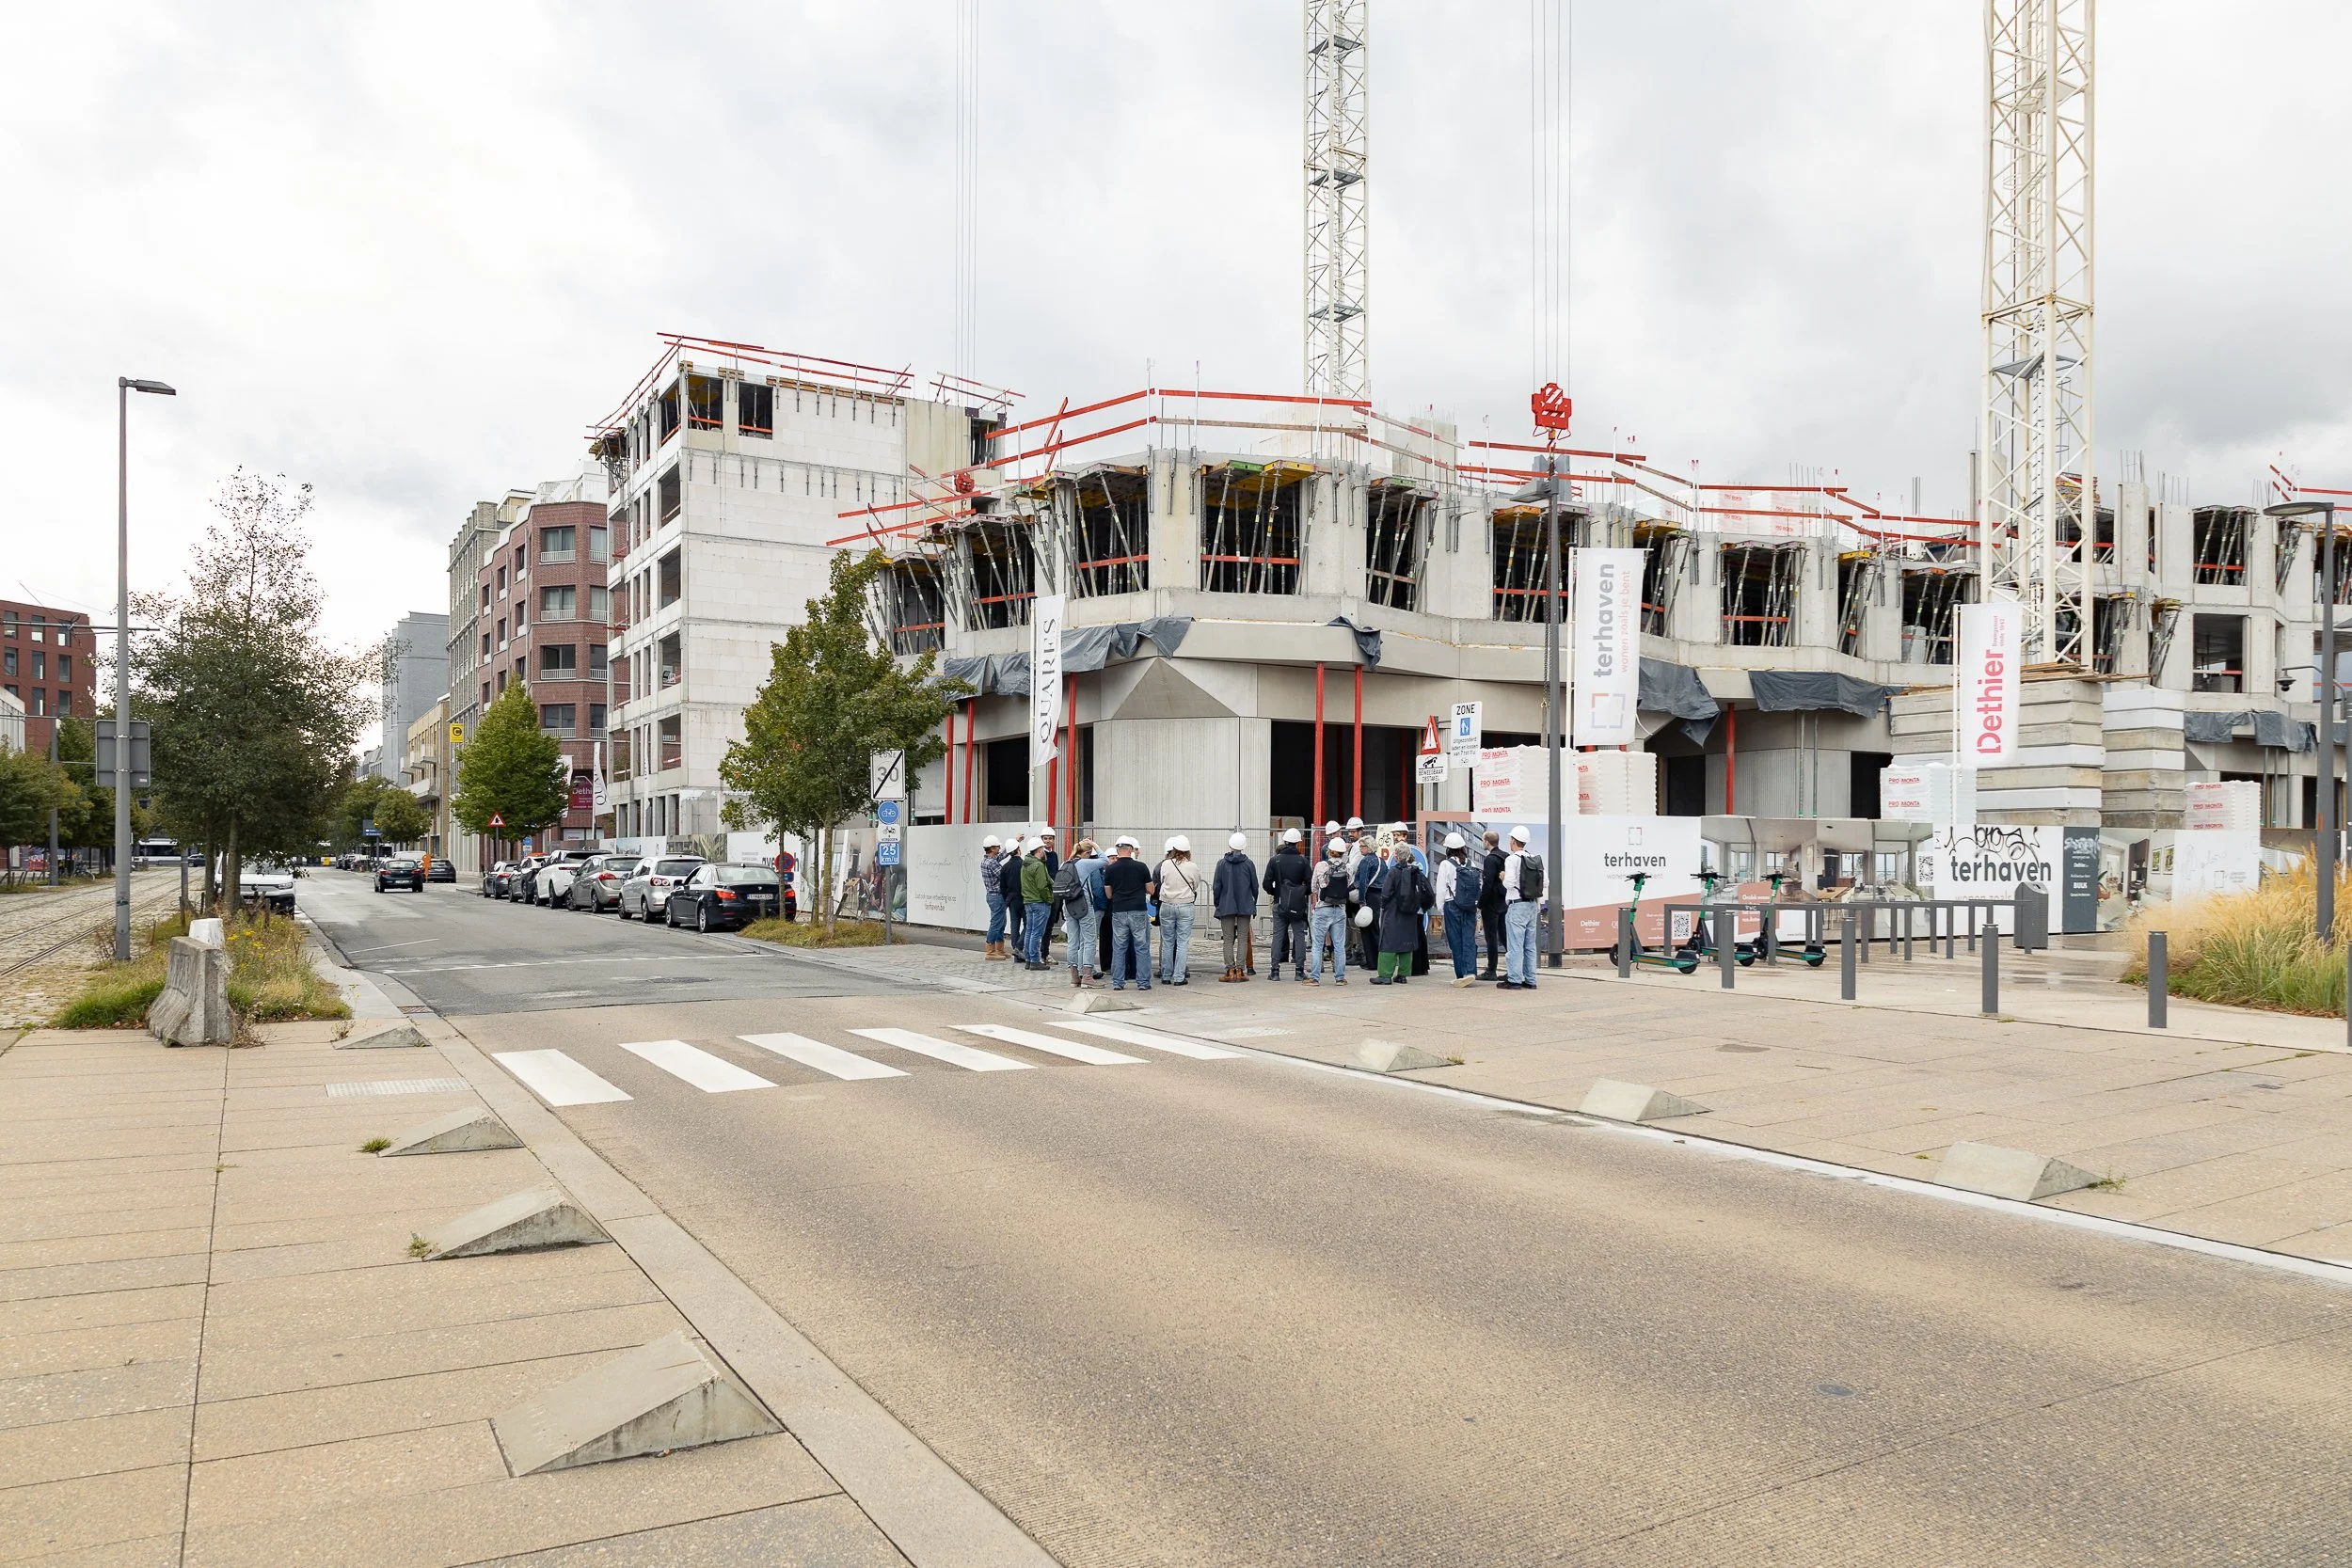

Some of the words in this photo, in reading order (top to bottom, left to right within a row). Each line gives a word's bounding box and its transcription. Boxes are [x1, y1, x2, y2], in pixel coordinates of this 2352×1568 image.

[1619, 570, 1630, 595] bent
[1621, 598, 1632, 610] je
[1593, 563, 1614, 678] terhaven
[1618, 610, 1629, 635] zoals
[1621, 638, 1629, 673] wonen
[1040, 618, 1057, 744] QUARES
[1456, 704, 1475, 715] ZONE
[1977, 649, 2004, 753] Dethier
[877, 767, 899, 782] 30
[882, 847, 897, 855] 25
[1604, 852, 1666, 867] terhaven
[1950, 854, 2052, 882] terhaven
